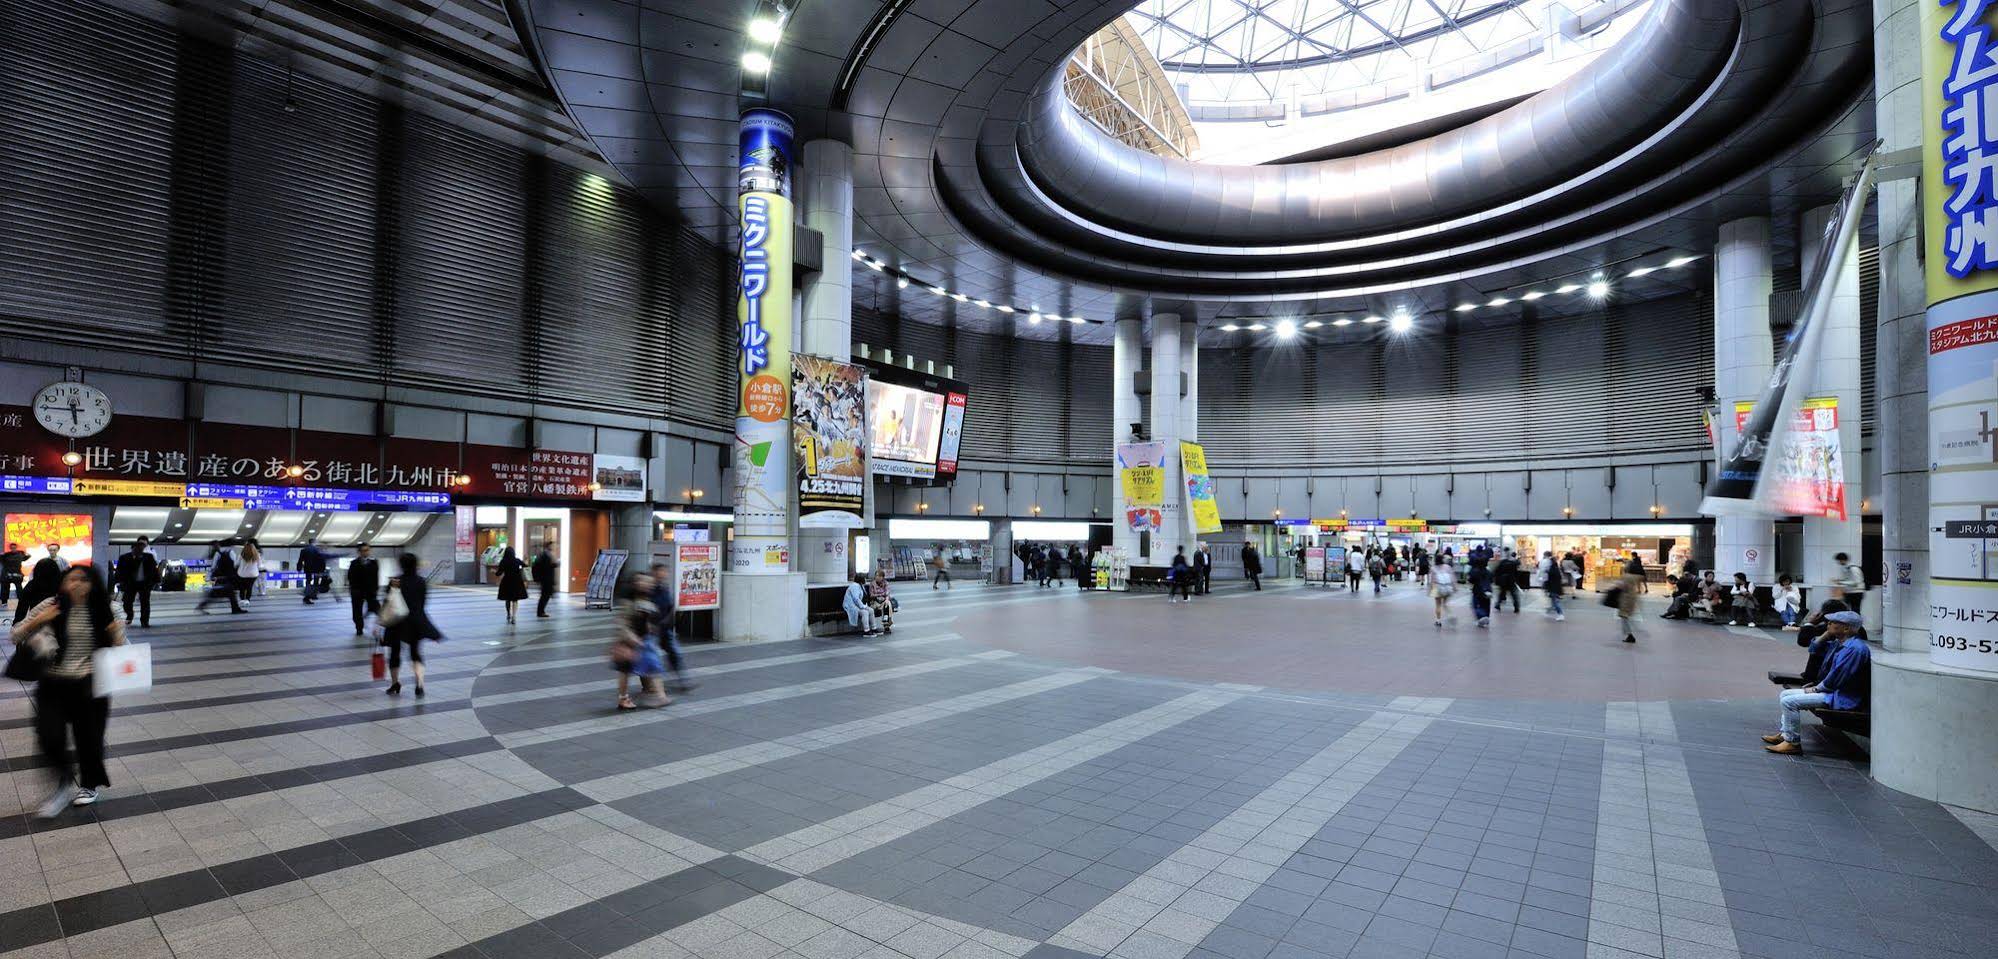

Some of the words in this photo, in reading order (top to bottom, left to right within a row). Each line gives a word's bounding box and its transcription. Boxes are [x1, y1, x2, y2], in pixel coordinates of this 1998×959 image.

[742, 197, 768, 372] ミクニワールド
[1931, 318, 1998, 341] ミクニワールド
[1931, 330, 1998, 351] スタジアム北九
[69, 387, 79, 395] 12
[0, 412, 22, 427] 産
[84, 446, 459, 489] 世界遺産のある街北九州市
[532, 452, 589, 466] 世界文化遺産
[1958, 524, 1998, 534] JR小倉
[1930, 604, 1998, 623] ニワールドス
